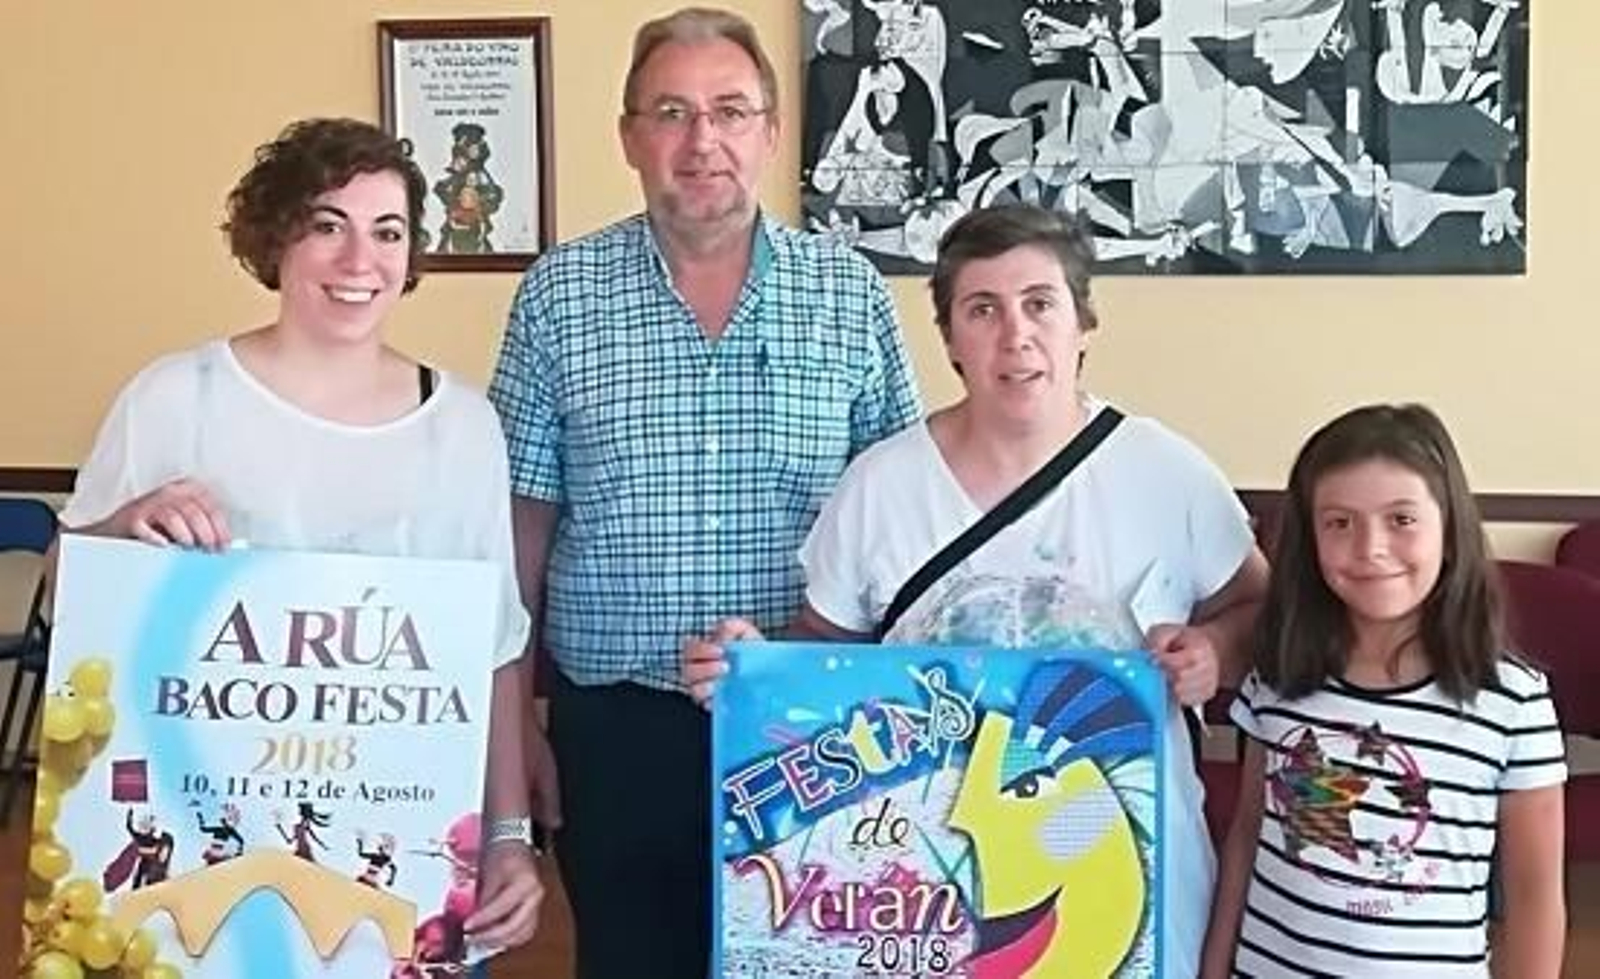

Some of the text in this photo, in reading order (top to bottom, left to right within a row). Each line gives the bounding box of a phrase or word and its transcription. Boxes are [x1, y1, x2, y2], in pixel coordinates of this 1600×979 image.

[200, 588, 432, 671] A RÚA
[156, 676, 471, 726] BACO FESTA
[249, 735, 358, 775] 2018
[181, 773, 436, 803] 10, 11 e 12 de Agosto
[850, 798, 909, 849] de
[731, 853, 967, 935] Verán
[856, 935, 952, 974] 2018
